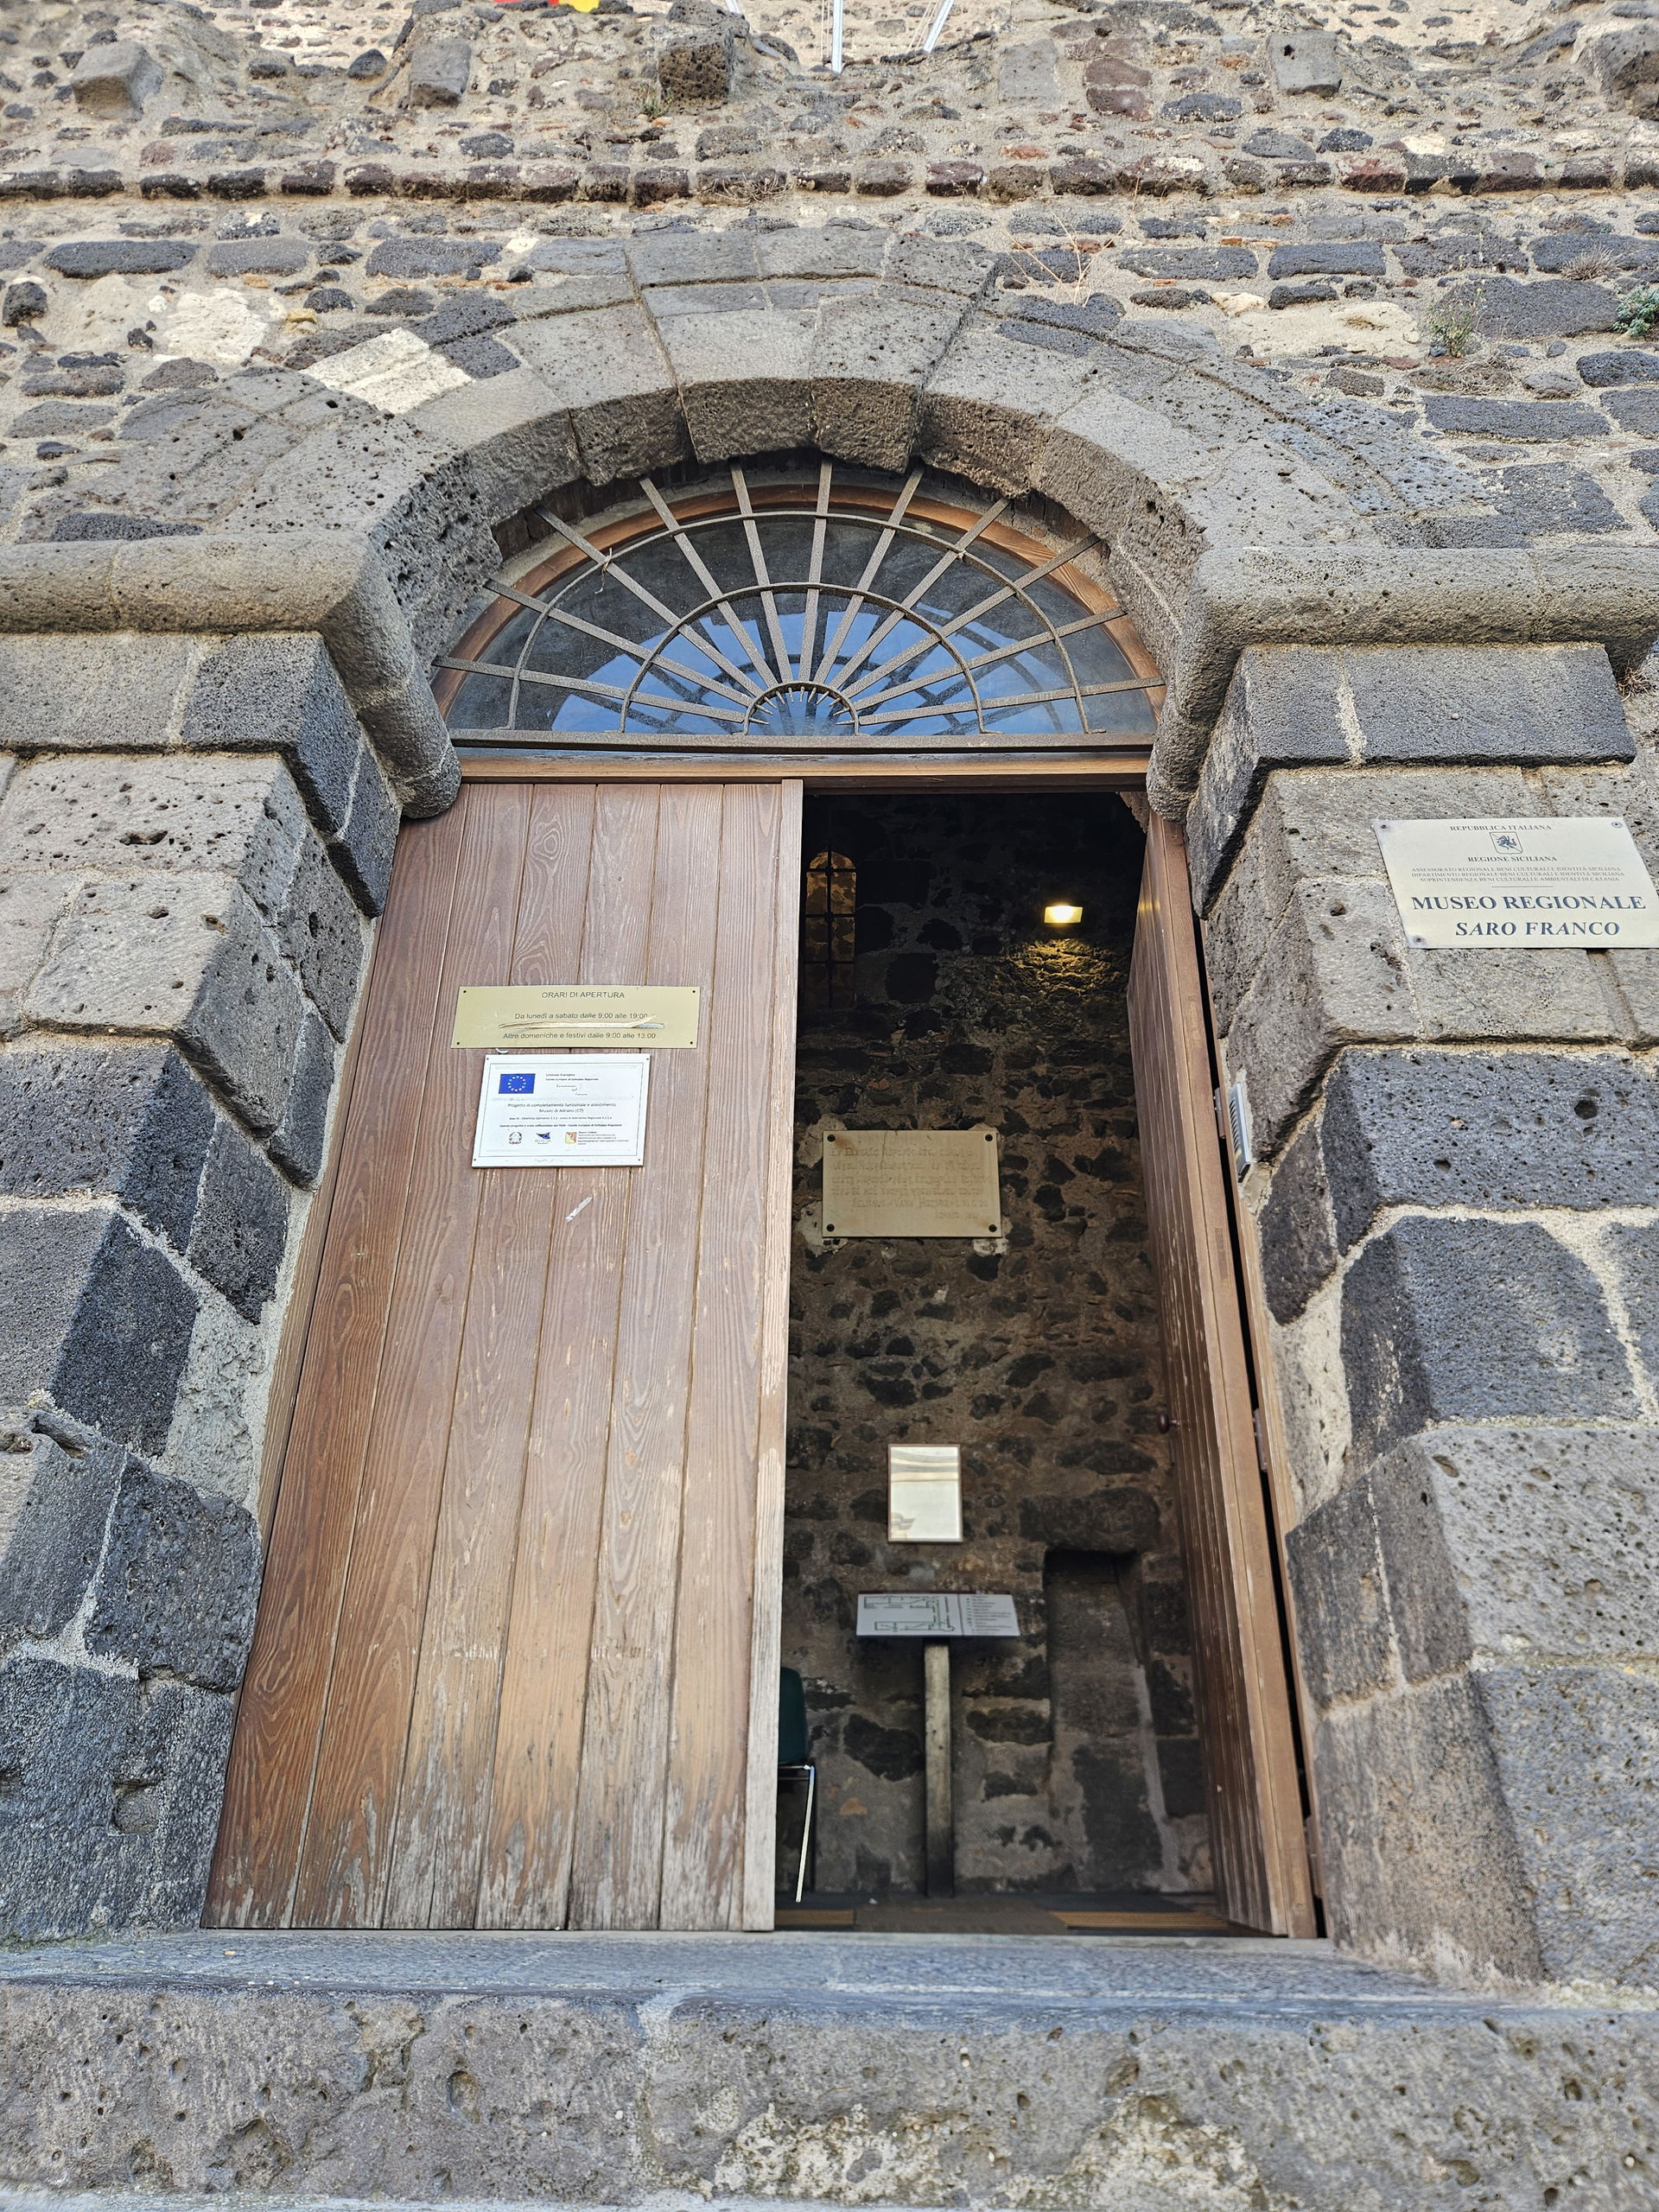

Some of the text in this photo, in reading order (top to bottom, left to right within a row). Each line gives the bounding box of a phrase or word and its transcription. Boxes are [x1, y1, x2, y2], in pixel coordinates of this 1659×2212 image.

[1411, 895, 1646, 910] MUSEO REGIONALE
[1455, 921, 1620, 936] SARO FRANCO
